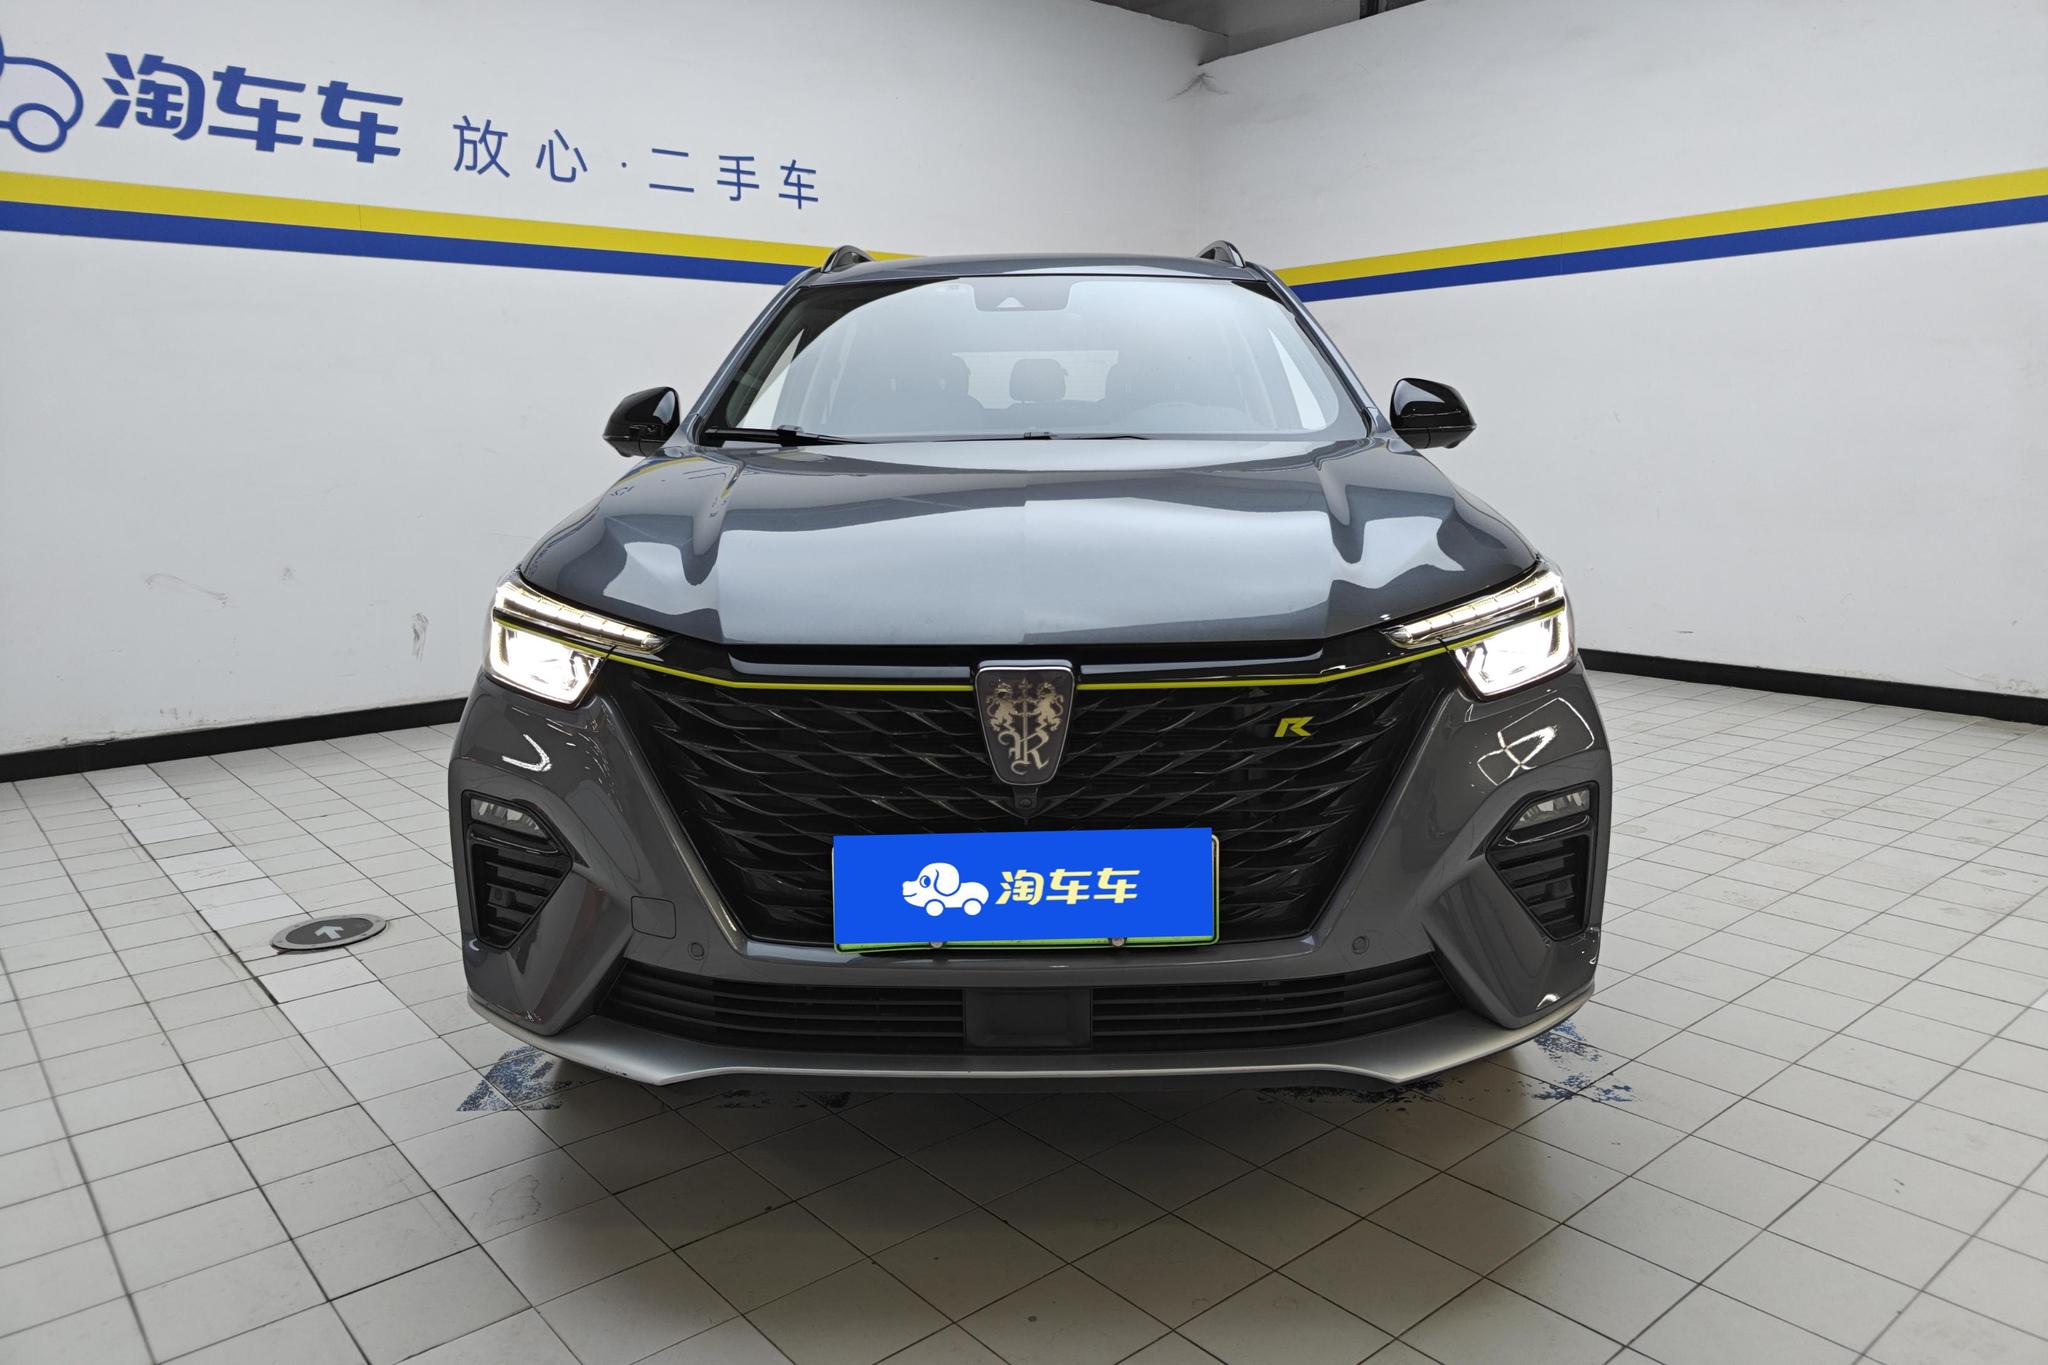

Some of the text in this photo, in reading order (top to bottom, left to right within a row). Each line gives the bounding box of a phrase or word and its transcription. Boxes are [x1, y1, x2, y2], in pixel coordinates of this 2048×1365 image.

[96, 52, 404, 164] 淘车车
[1274, 716, 1313, 738] R
